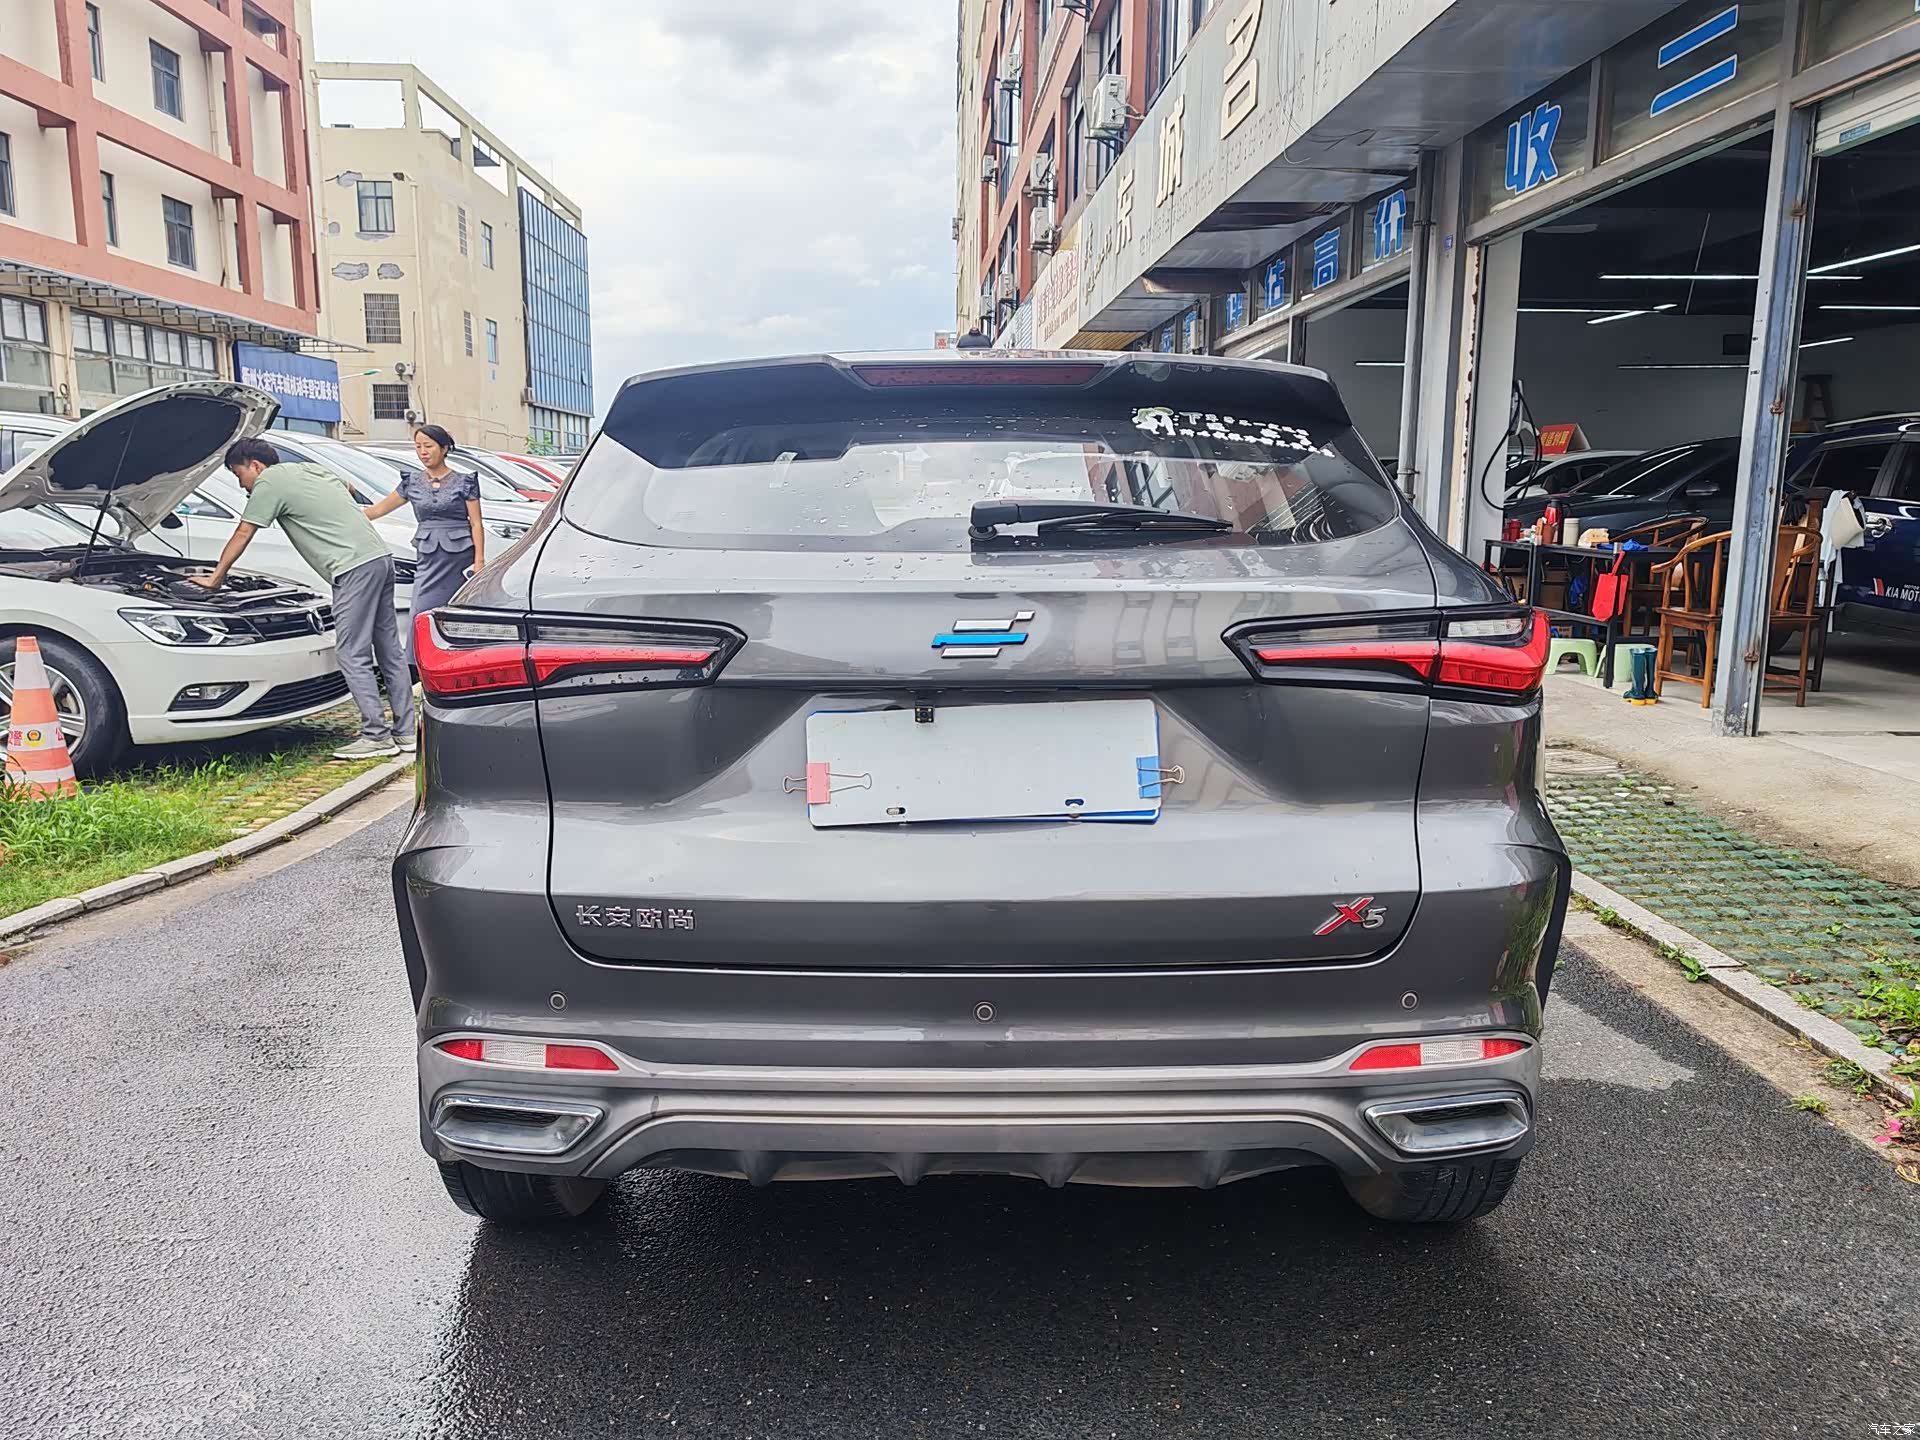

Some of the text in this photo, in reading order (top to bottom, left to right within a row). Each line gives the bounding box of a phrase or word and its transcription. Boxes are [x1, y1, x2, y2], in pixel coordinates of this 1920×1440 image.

[1885, 586, 1920, 602] KIA MOT
[575, 905, 695, 930] 长安欧尚
[1312, 896, 1388, 936] X5
